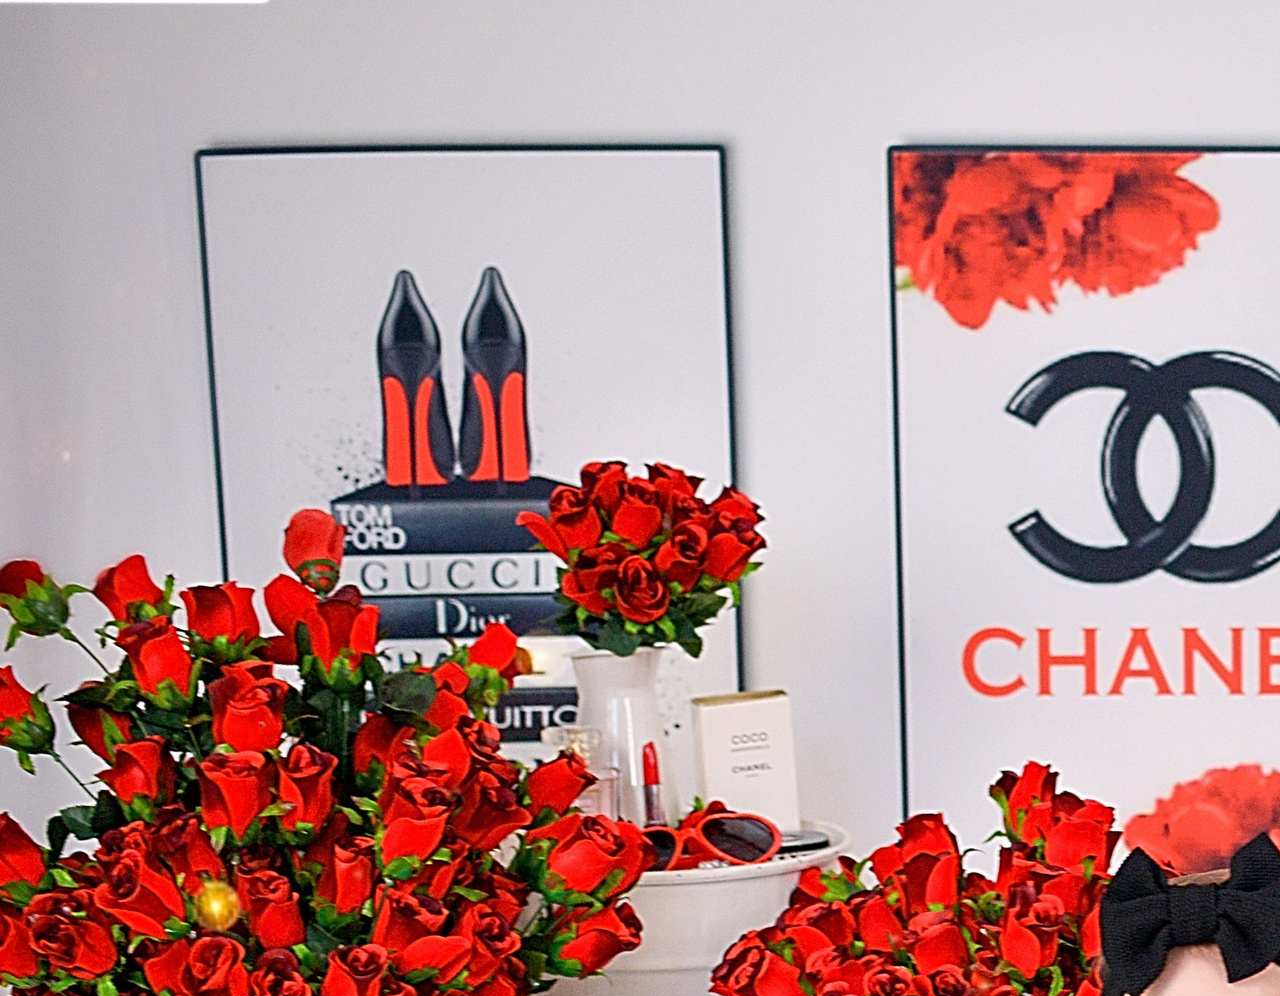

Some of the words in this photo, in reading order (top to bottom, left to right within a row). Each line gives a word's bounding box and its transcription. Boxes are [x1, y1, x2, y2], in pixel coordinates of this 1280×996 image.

[334, 503, 393, 527] TOM
[360, 558, 540, 592] GUCCI
[731, 732, 769, 745] COCO
[731, 763, 773, 774] CHANEL
